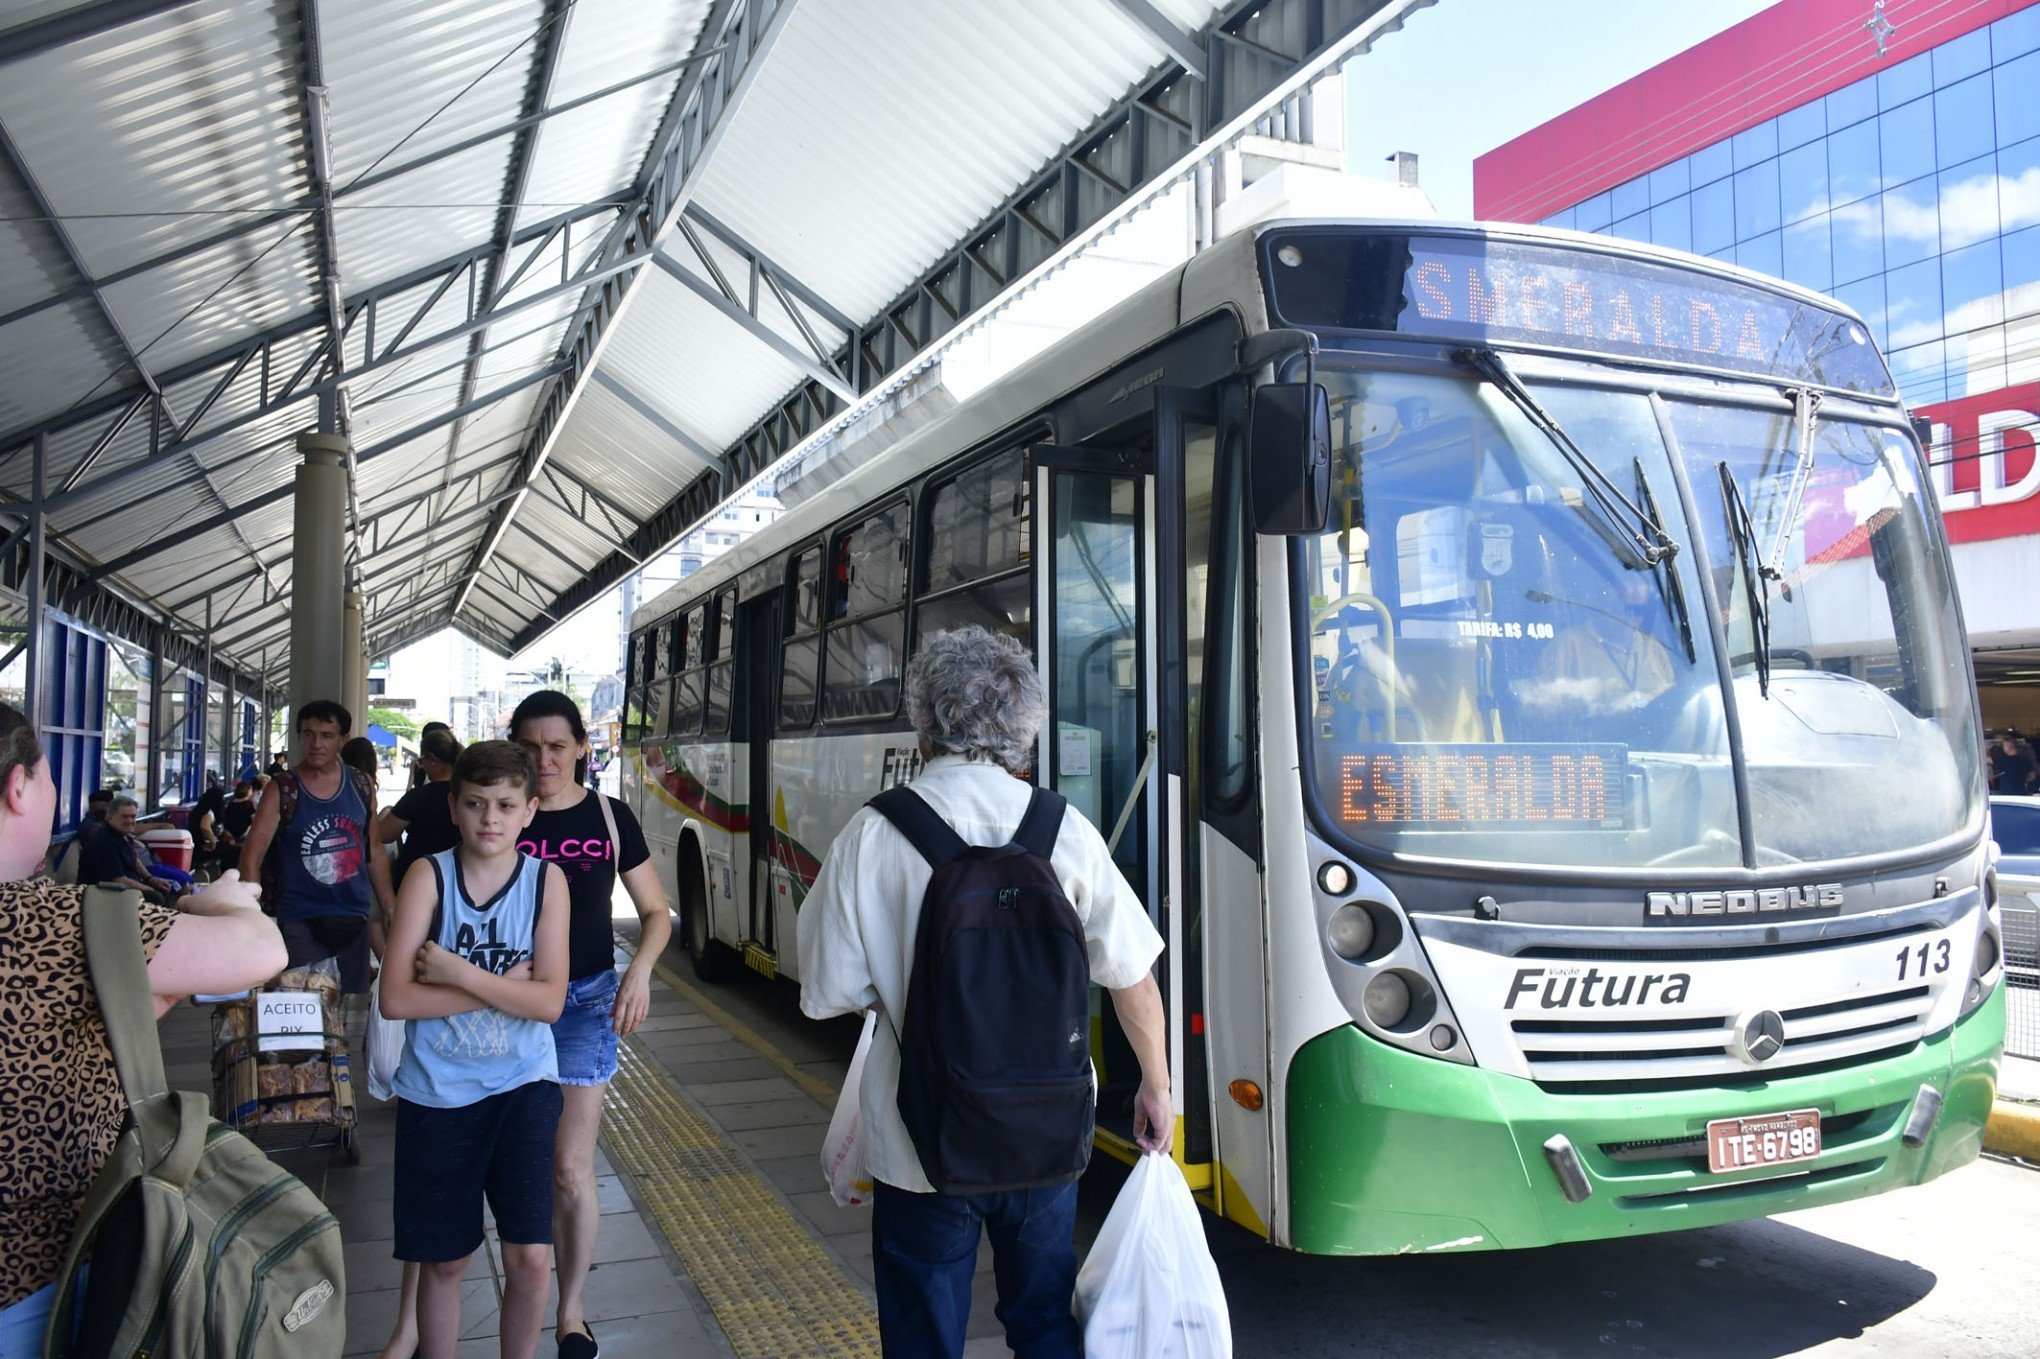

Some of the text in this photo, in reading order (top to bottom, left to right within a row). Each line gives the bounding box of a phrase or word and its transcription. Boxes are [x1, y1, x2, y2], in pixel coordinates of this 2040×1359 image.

[1457, 620, 1503, 638] TARIFA:
[1504, 622, 1522, 639] R$
[1342, 755, 1605, 820] ESMERALDA
[300, 818, 330, 855] ENDLESS
[1647, 882, 1844, 916] NEOBUS
[1896, 938, 1950, 981] 113
[1503, 967, 1691, 1010] Futura
[263, 1003, 316, 1016] ACEITO
